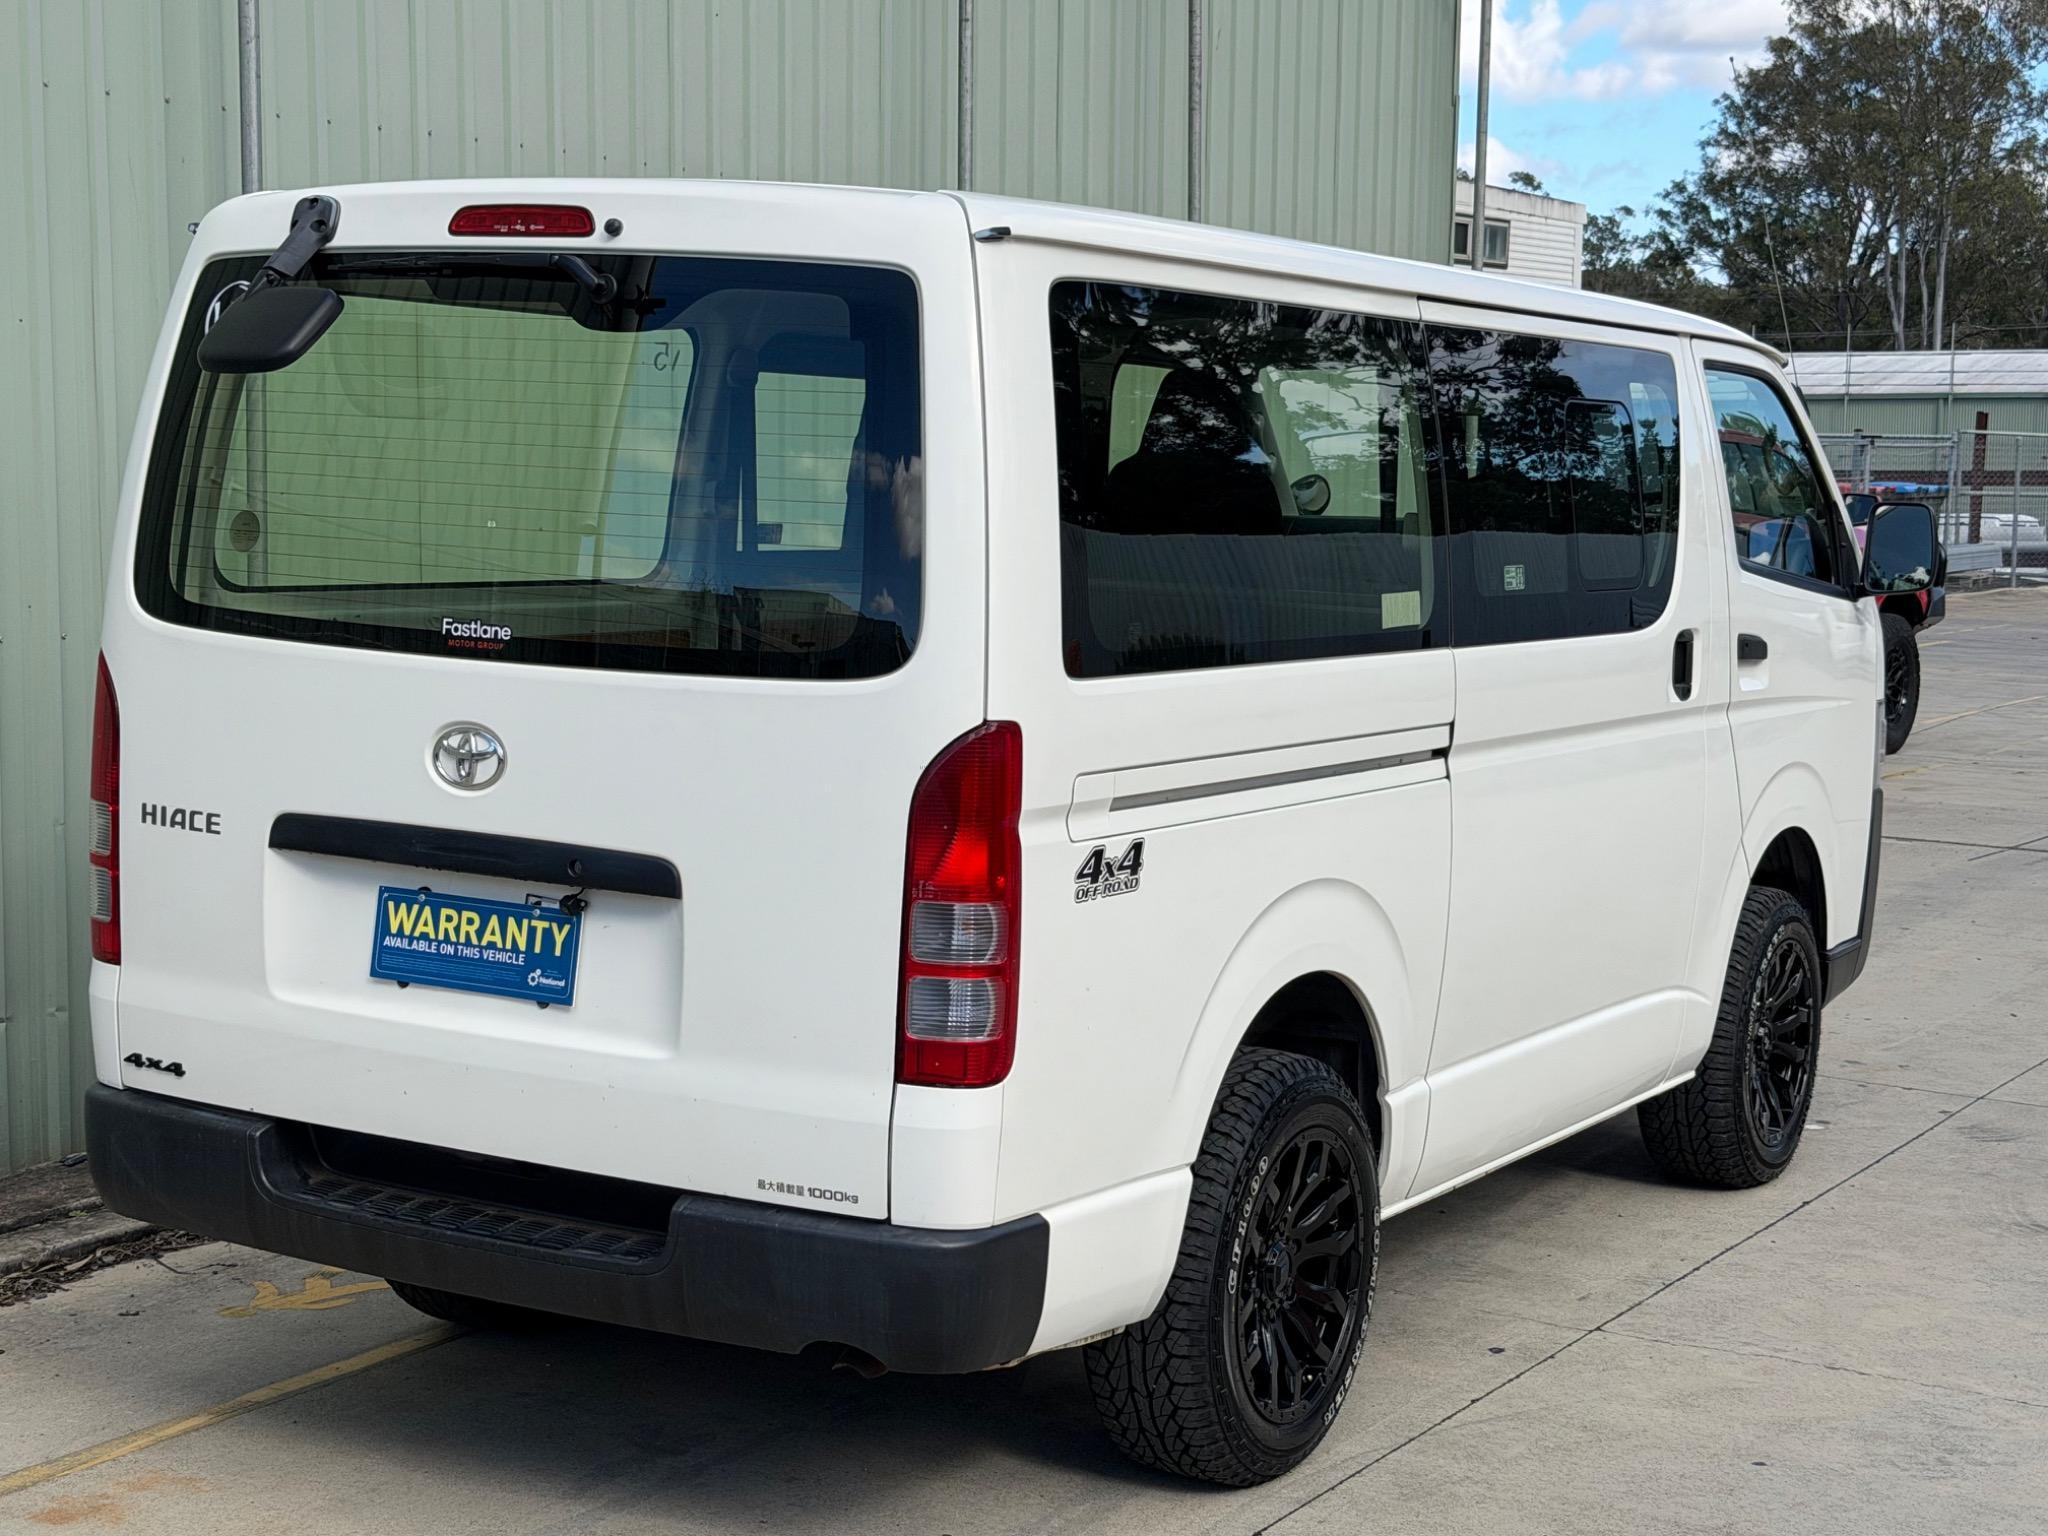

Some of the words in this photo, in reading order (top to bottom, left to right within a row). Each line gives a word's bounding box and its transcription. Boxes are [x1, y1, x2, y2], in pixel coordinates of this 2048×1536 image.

[442, 617, 512, 640] Fastlane
[448, 639, 475, 648] MOTOR
[477, 641, 504, 650] GROUP
[141, 802, 221, 835] HIACE
[1075, 838, 1144, 885] 4x4
[1076, 885, 1101, 901] OFF
[1101, 877, 1139, 896] ROAD
[387, 900, 571, 957] WARRANTY
[383, 935, 438, 953] AVAILABLE
[439, 944, 453, 956] ON
[456, 945, 480, 959] THIS
[482, 950, 526, 966] VEHICLE
[123, 1052, 186, 1077] 4x4
[807, 1186, 859, 1205] 1000kg
